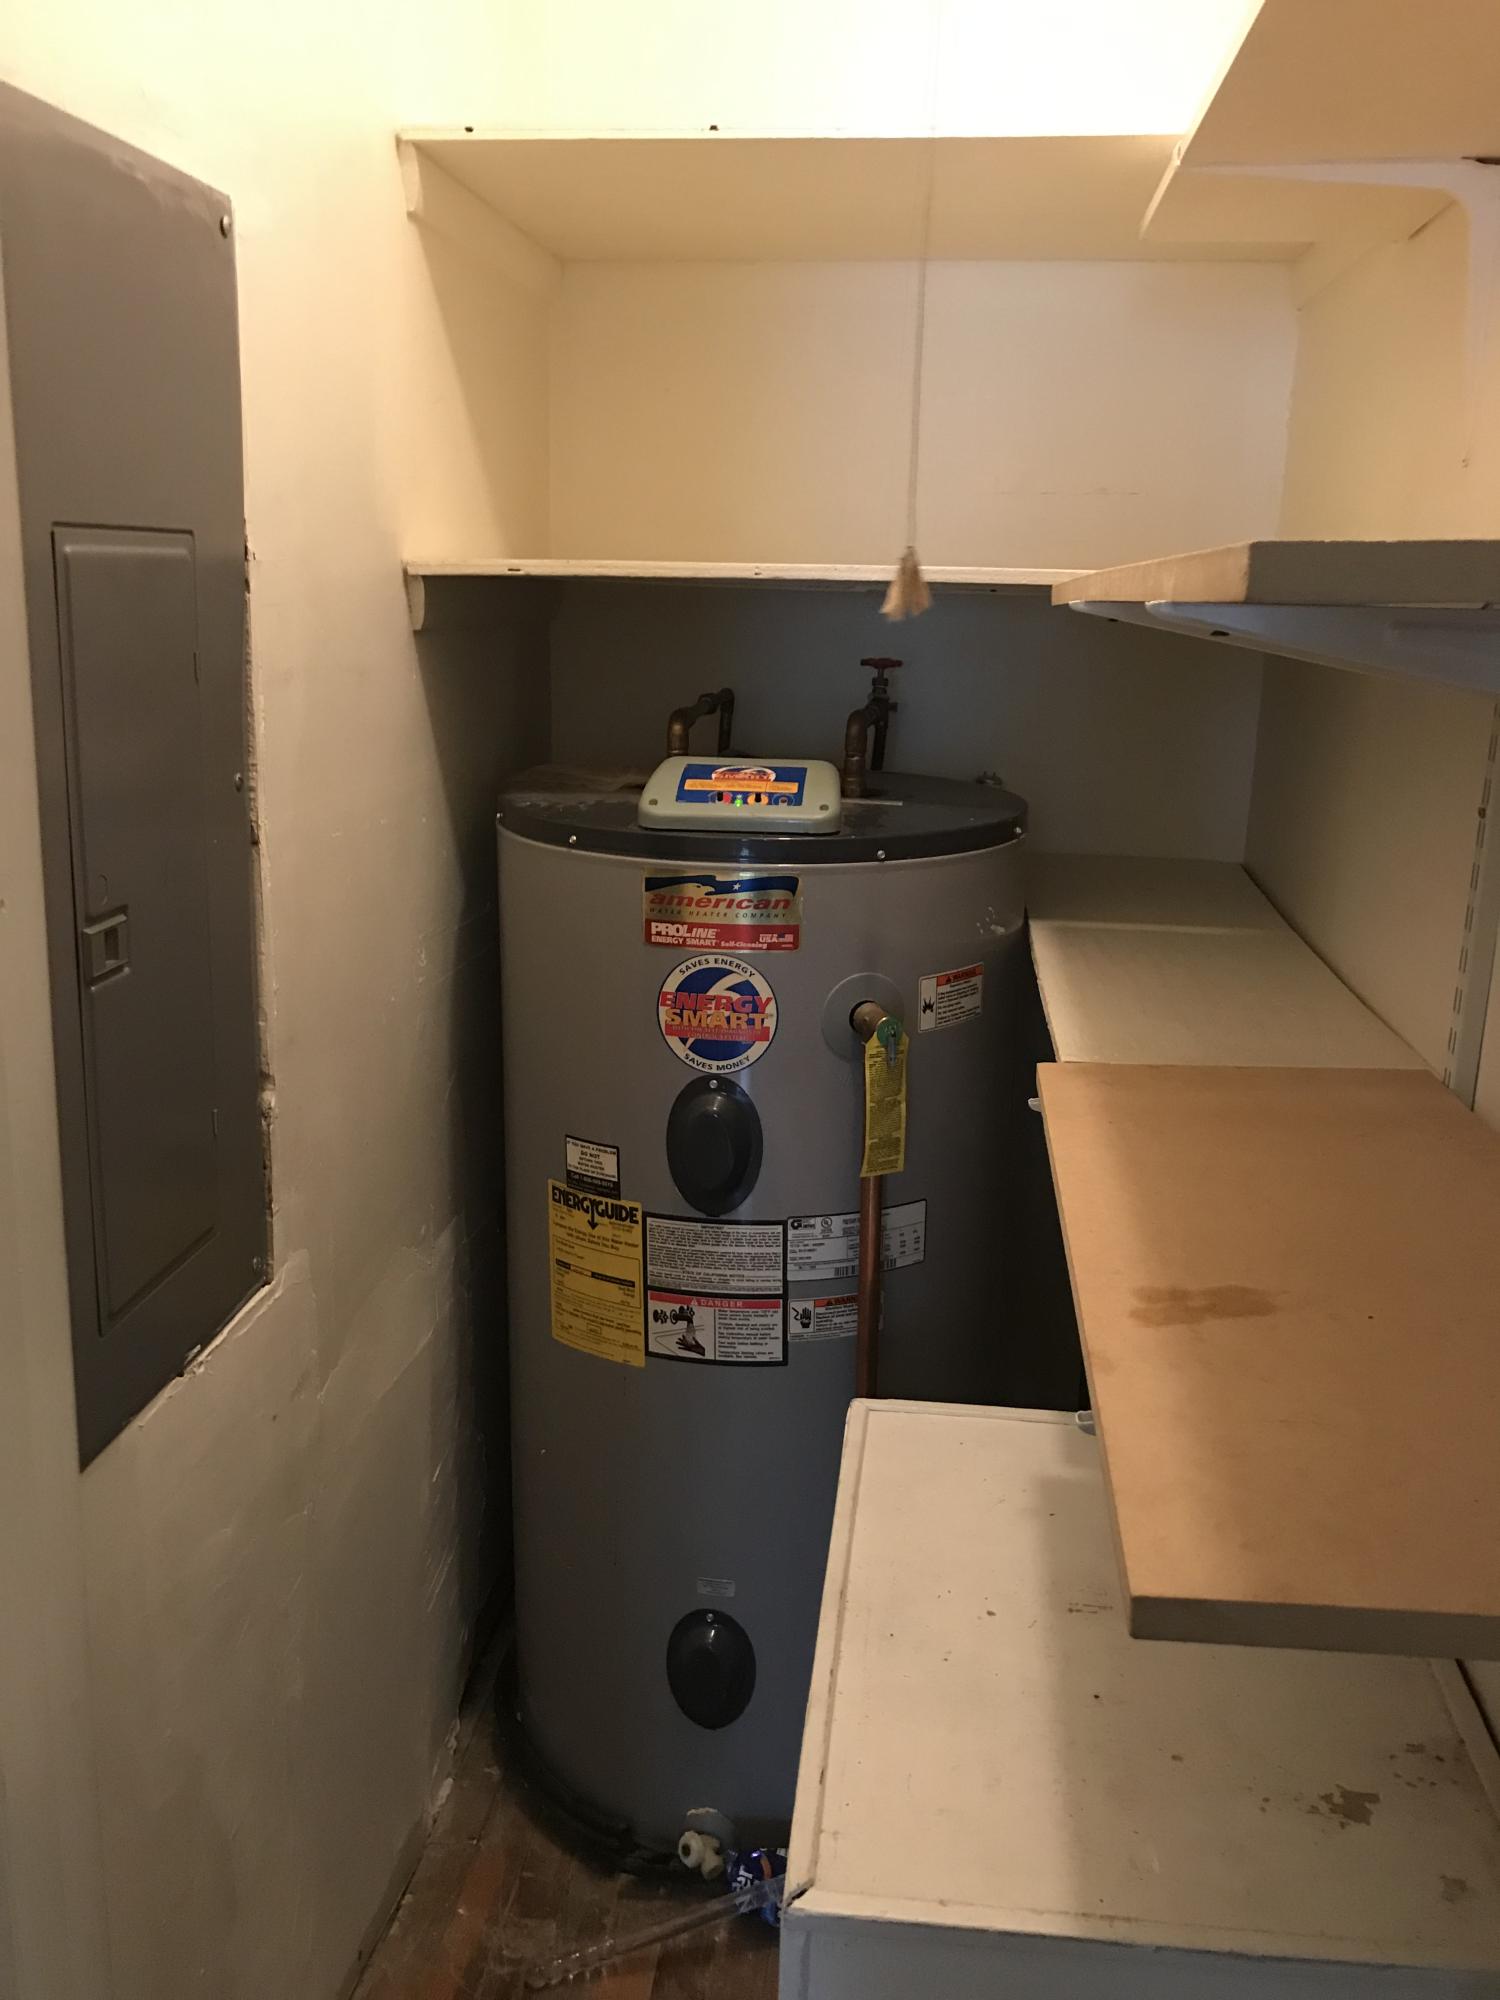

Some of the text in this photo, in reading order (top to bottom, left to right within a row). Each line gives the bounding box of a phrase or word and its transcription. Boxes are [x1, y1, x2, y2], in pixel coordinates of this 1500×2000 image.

[649, 892, 792, 910] american
[688, 910, 728, 918] HEATER
[735, 911, 787, 919] COMPANY
[651, 936, 768, 949] ENERGY SMART Self-Cleaning
[679, 957, 756, 978] SAVES ENERGY
[659, 991, 773, 1014] ENERGY
[665, 1007, 769, 1031] SMART
[684, 1053, 751, 1071] SAVES MONEY
[551, 1185, 639, 1225] ENERGYGUIDE
[700, 1299, 743, 1308] DANGER
